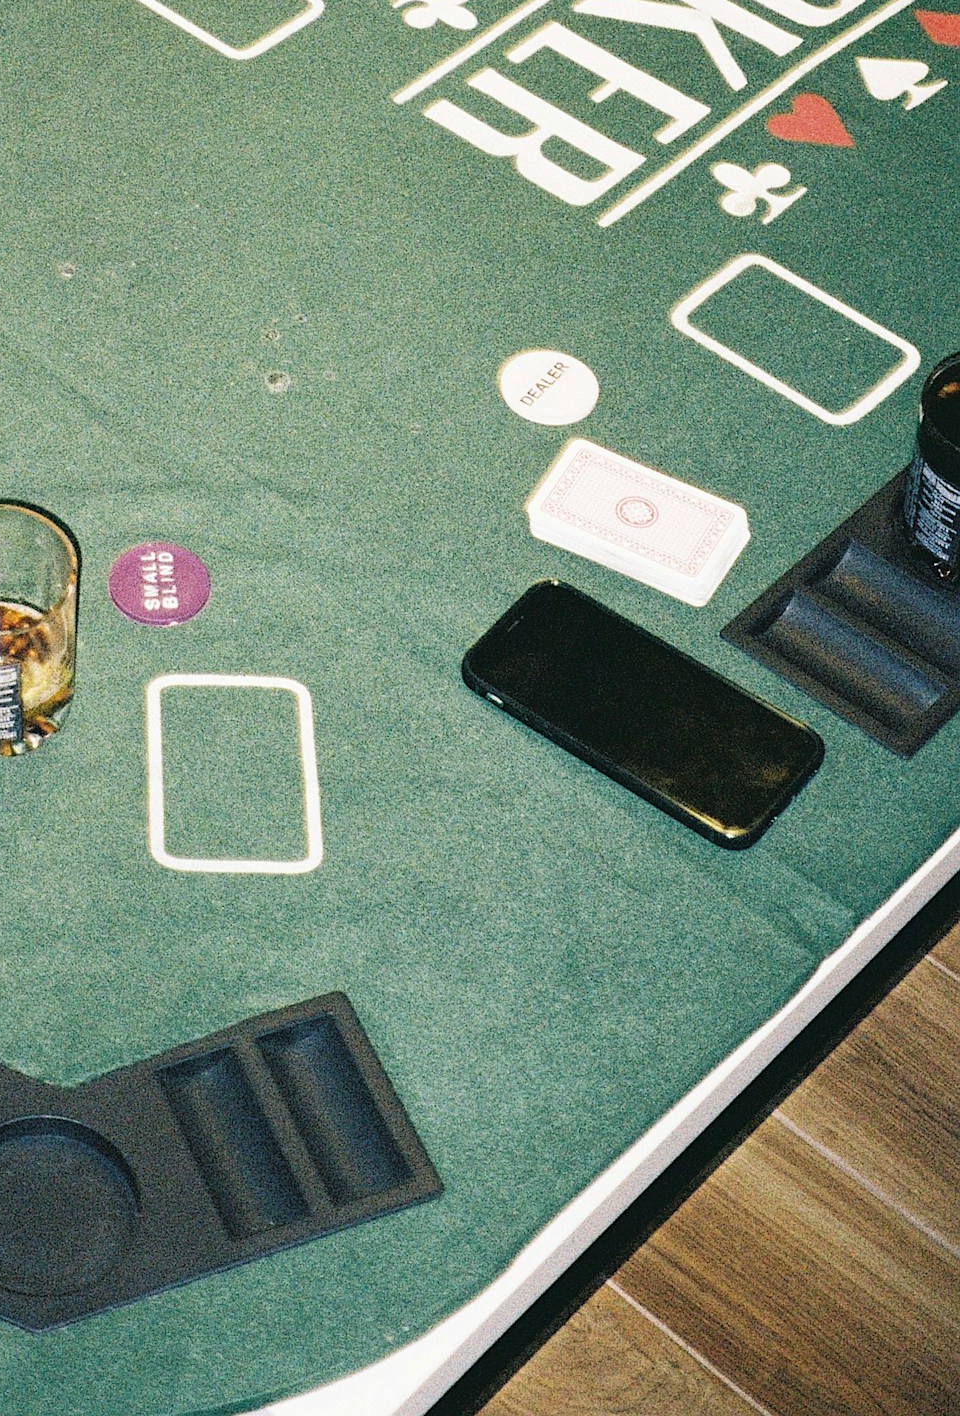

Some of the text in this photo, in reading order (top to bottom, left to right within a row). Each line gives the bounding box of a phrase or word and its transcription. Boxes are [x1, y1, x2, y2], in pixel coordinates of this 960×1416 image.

[519, 361, 571, 407] DEALER
[140, 551, 161, 611] SMALL
[157, 551, 179, 610] BLIND
